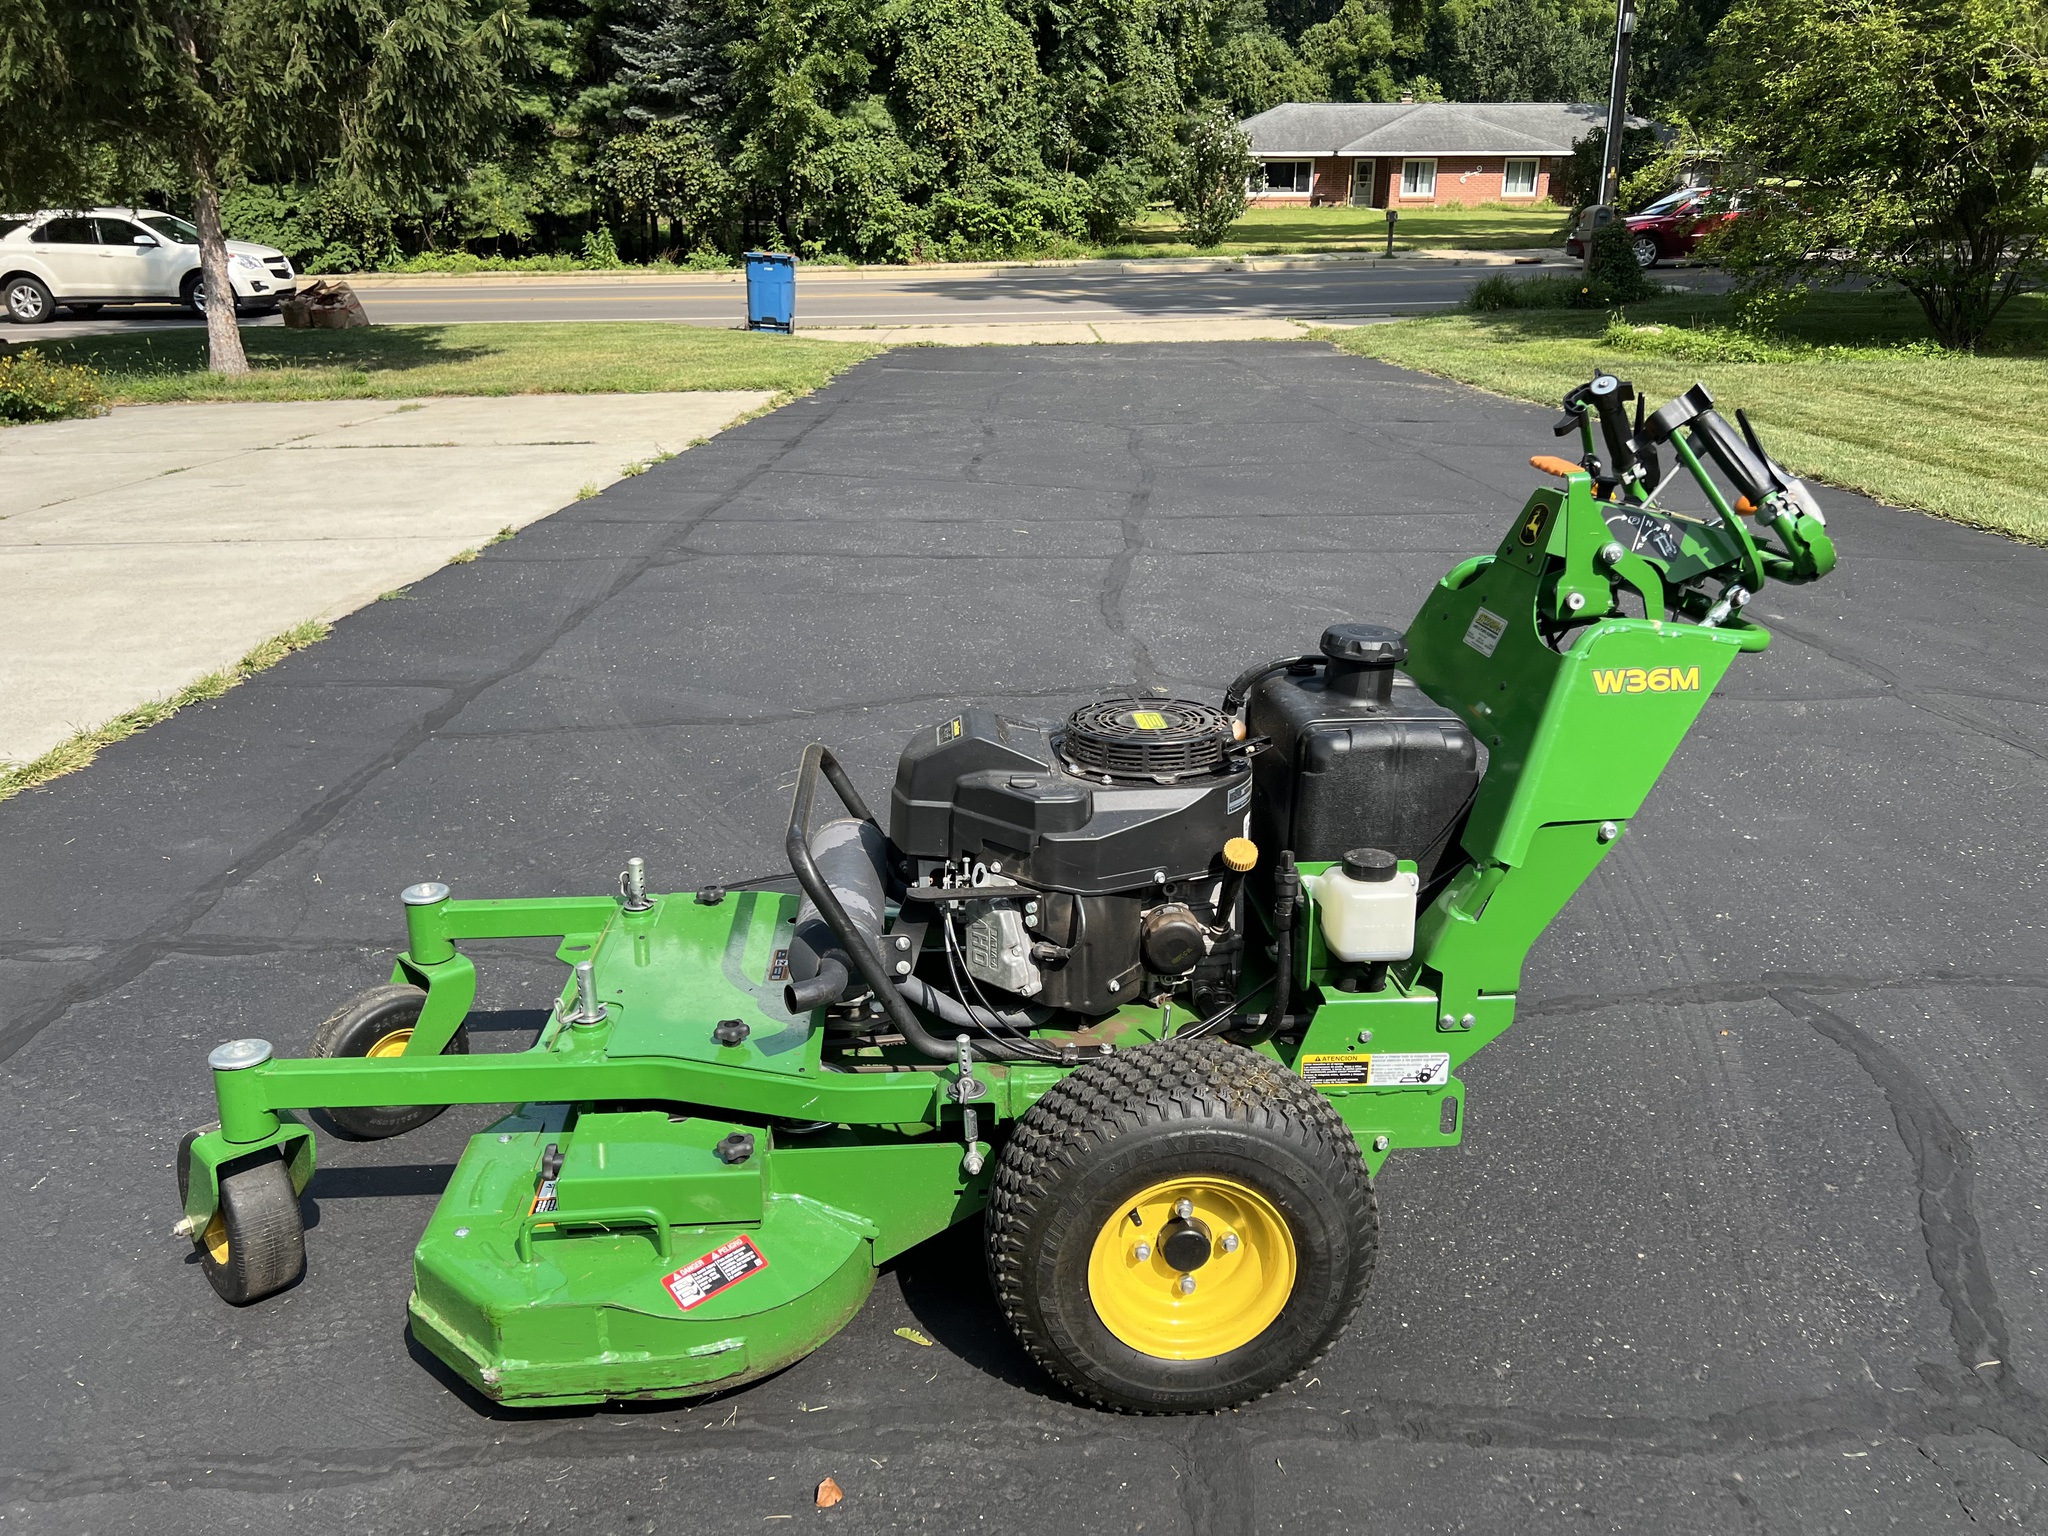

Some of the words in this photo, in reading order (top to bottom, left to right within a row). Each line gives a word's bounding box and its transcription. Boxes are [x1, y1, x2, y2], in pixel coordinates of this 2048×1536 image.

[1645, 520, 1654, 528] N
[1663, 523, 1671, 532] R
[1636, 542, 1645, 550] F
[1592, 666, 1700, 694] W36M
[971, 919, 989, 968] OHV
[1038, 1184, 1086, 1267] TURF
[718, 1238, 743, 1256] PELIGRO
[680, 1259, 705, 1276] DANGER
[1038, 1295, 1107, 1381] SUPER
